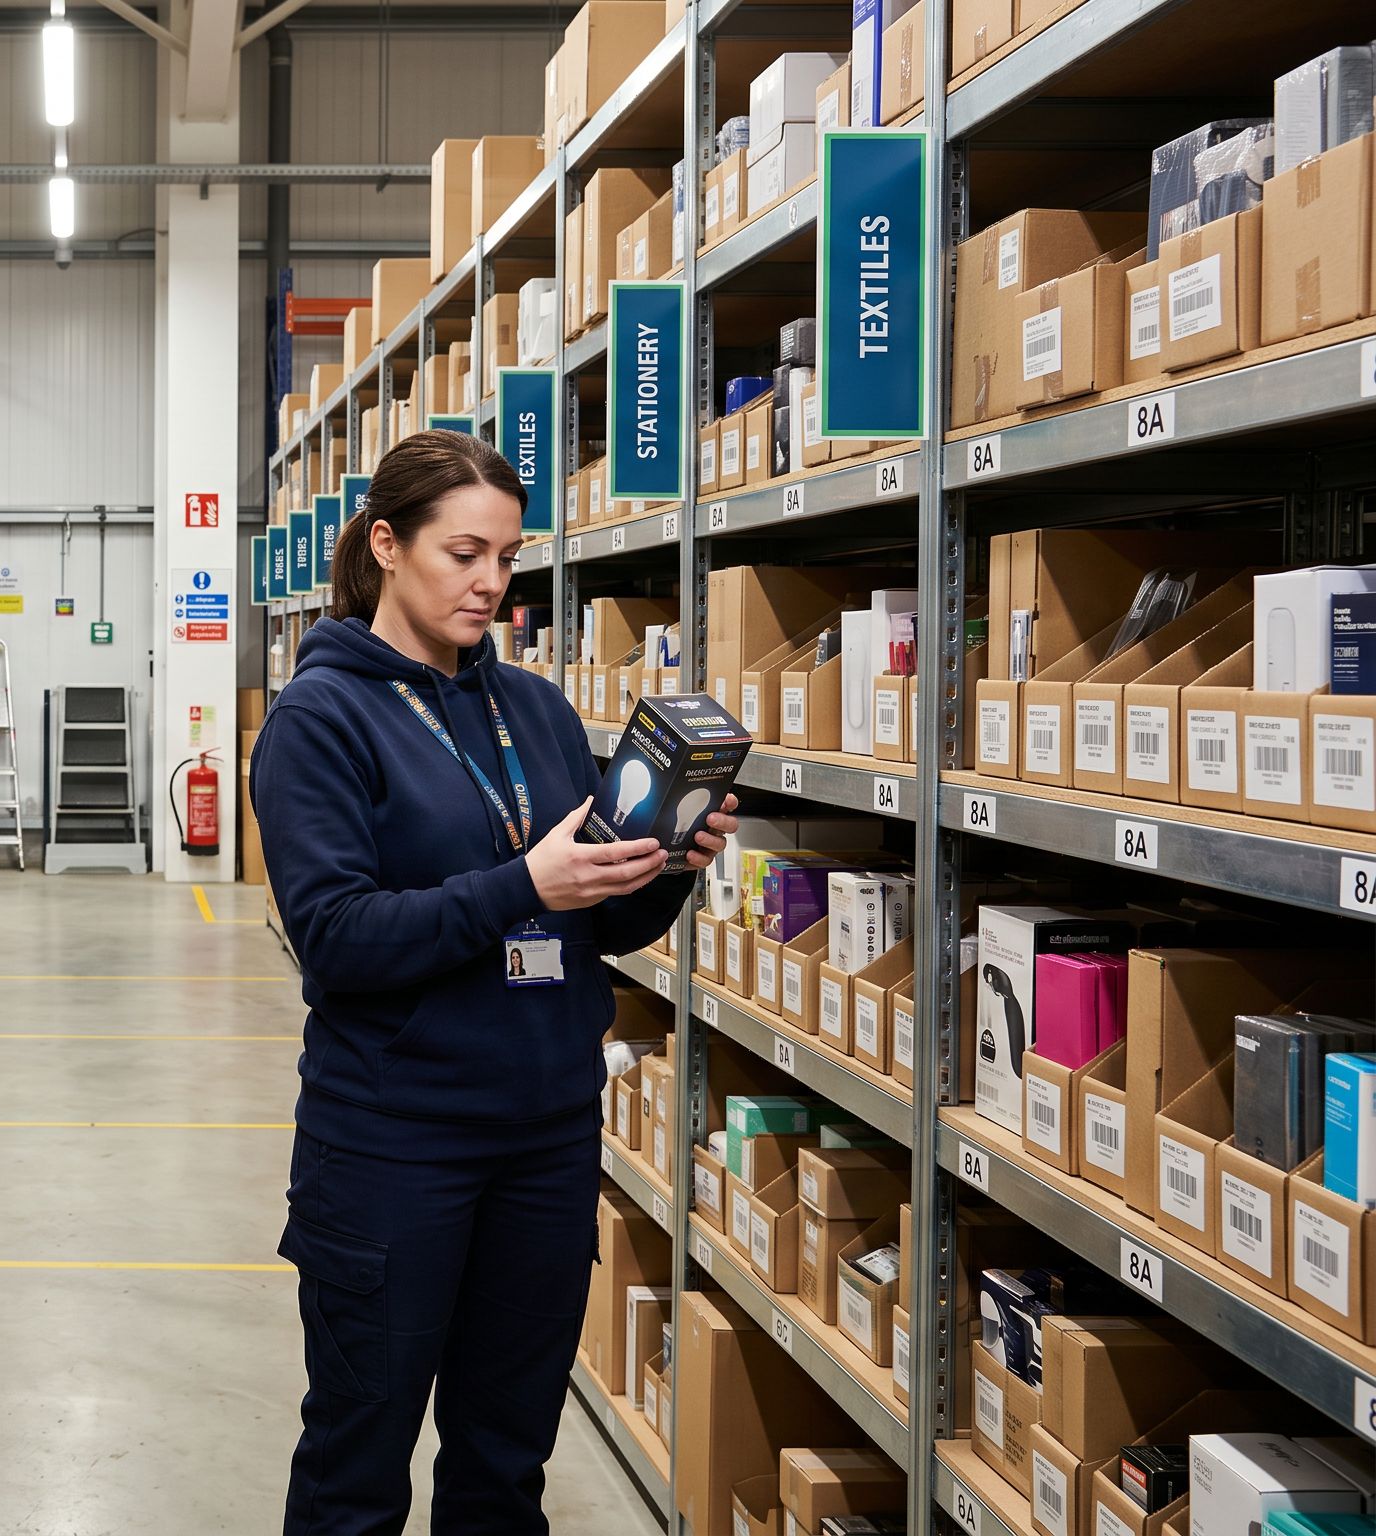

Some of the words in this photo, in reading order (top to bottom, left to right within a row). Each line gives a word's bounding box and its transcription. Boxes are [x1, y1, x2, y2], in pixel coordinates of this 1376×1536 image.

[859, 215, 890, 359] TEXTILES
[636, 322, 659, 459] STATIONERY
[1137, 403, 1165, 438] 8A
[974, 442, 995, 473] 8A
[882, 466, 897, 491] 8A
[879, 784, 894, 808] 8A
[970, 801, 990, 827] 8A
[1124, 829, 1148, 860] 8A
[965, 1151, 983, 1183] 8A
[1130, 1252, 1153, 1290] 8A
[958, 1493, 976, 1531] 8A
